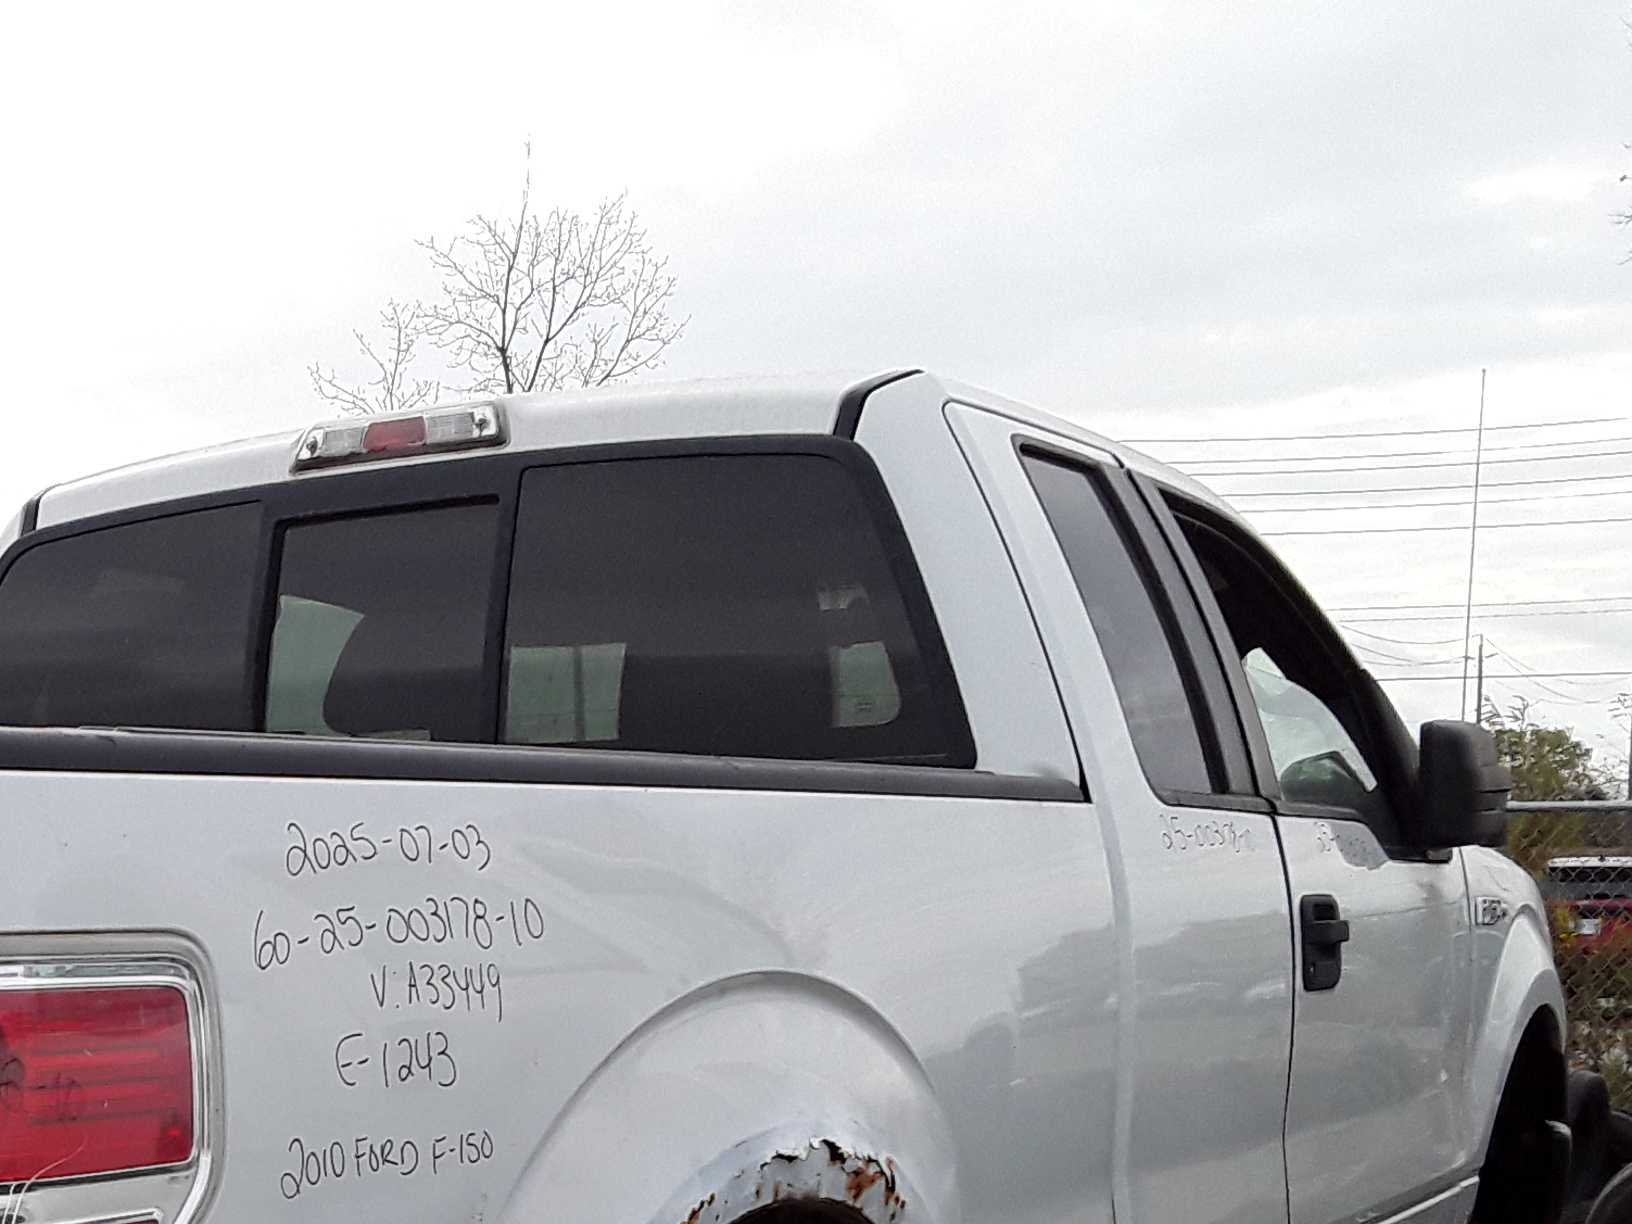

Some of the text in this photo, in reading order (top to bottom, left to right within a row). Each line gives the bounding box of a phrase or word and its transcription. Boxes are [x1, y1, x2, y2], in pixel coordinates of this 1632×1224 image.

[285, 821, 491, 877] 2025-07-03
[254, 896, 545, 970] 60-25-003178-10
[335, 1031, 457, 1088] E-1243
[280, 1129, 494, 1199] 2010 FORD F-150
